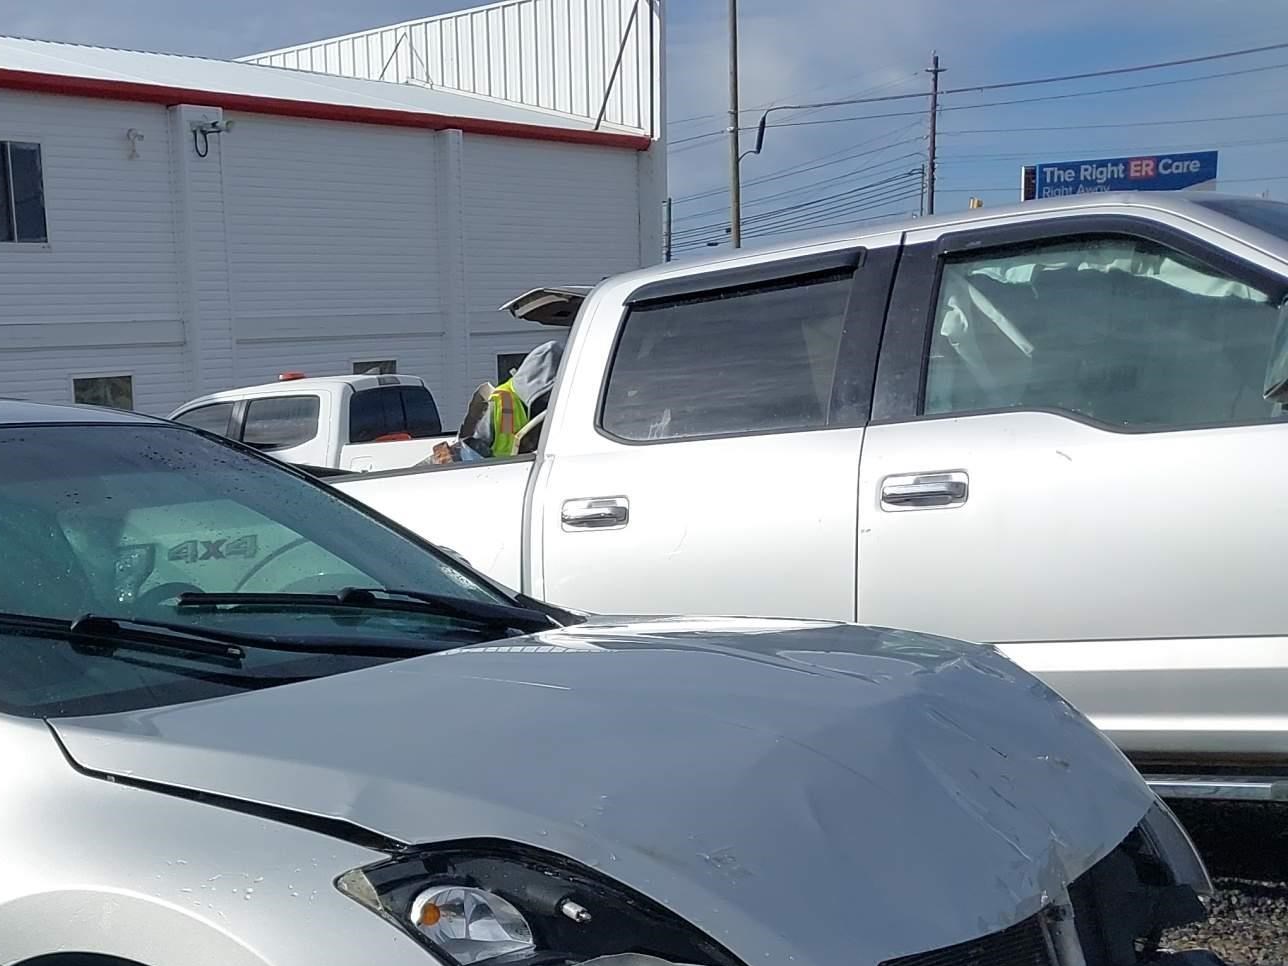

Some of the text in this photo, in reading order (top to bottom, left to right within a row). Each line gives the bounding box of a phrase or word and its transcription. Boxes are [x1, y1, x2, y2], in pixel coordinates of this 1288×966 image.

[1043, 158, 1200, 183] The Right ER Care
